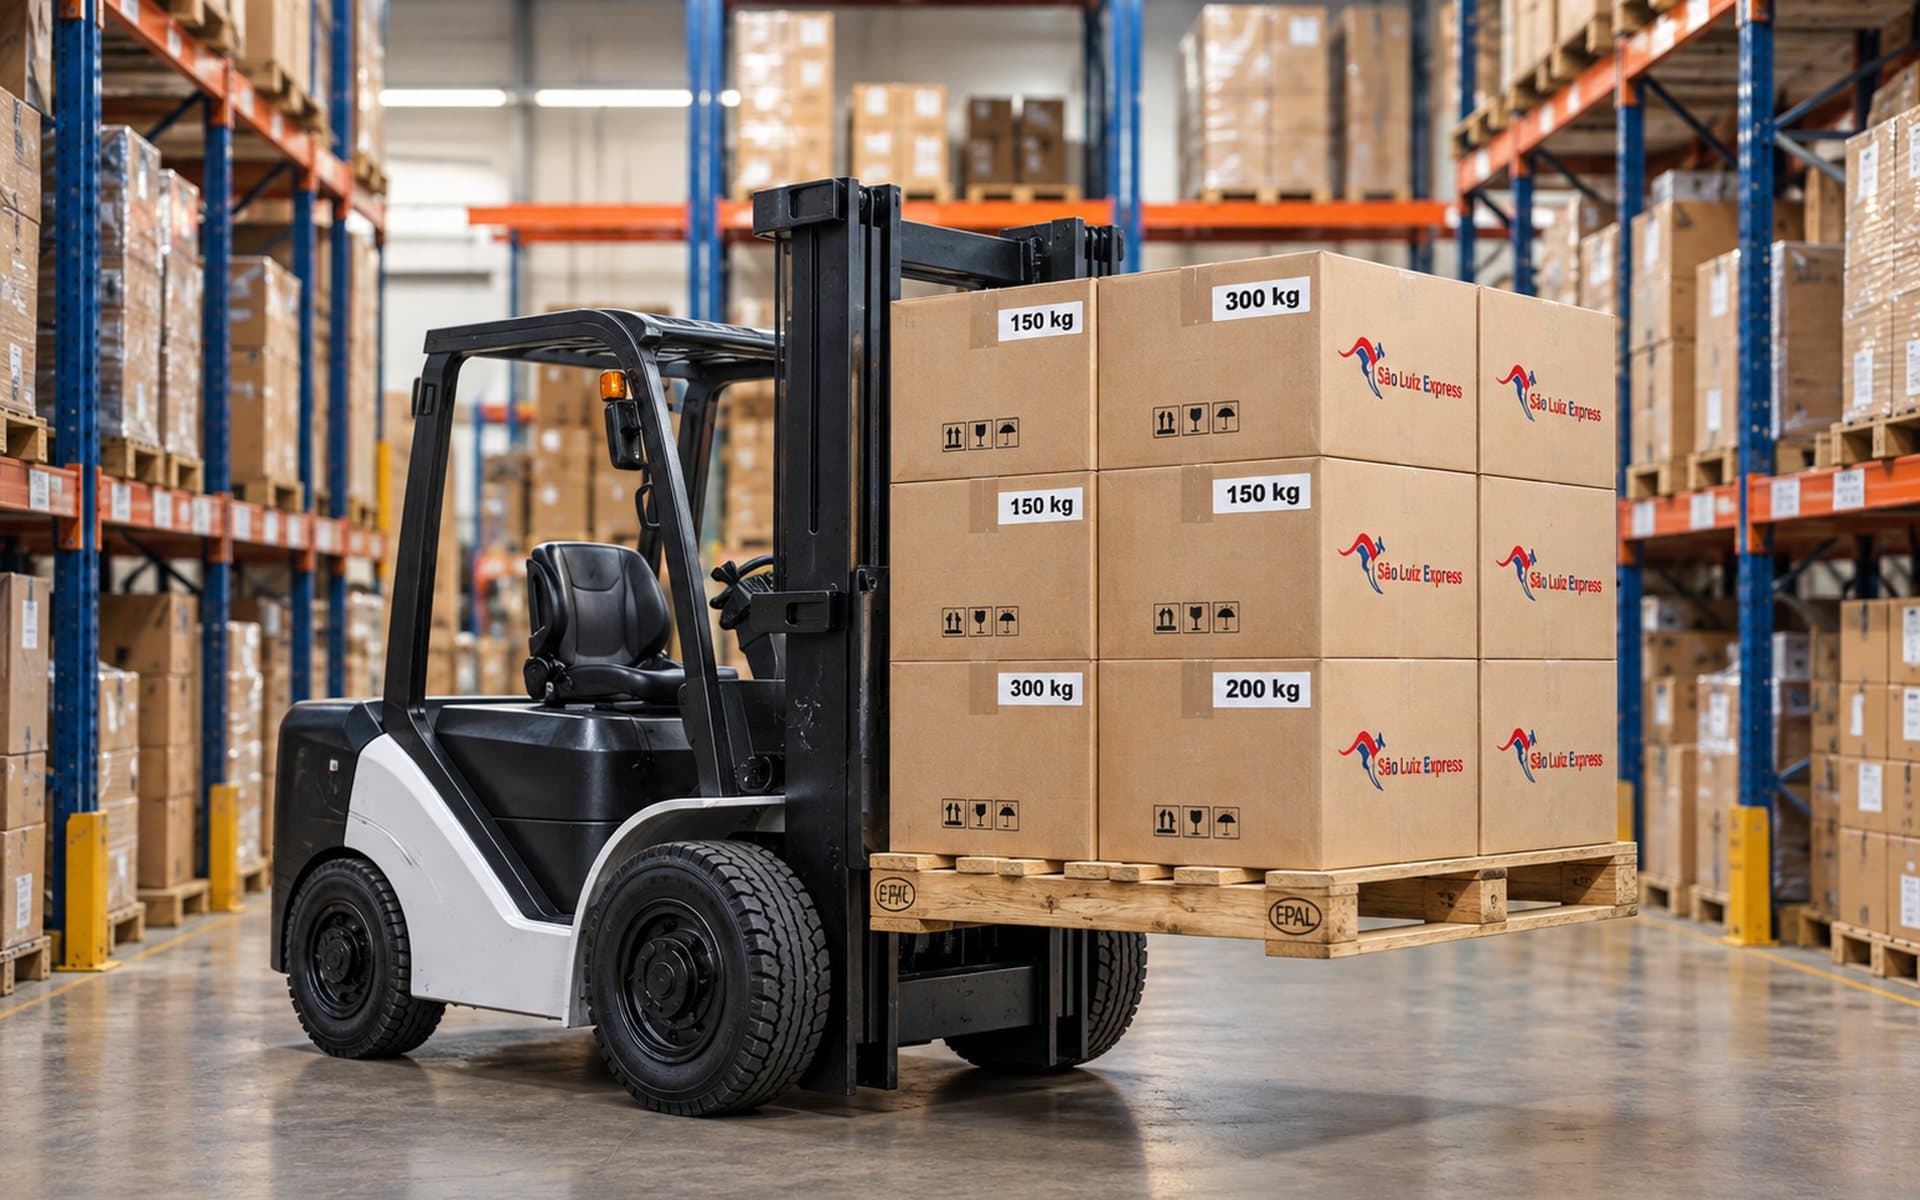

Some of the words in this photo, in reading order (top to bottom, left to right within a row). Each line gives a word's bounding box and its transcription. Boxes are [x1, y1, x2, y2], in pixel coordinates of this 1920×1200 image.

[1226, 288, 1266, 311] 300
[1272, 286, 1300, 309] kg
[1010, 312, 1044, 332] 150
[1050, 310, 1074, 331] kg
[1378, 367, 1397, 386] São
[1400, 371, 1421, 391] Luiz
[1424, 375, 1462, 399] Express
[1530, 393, 1547, 411] São
[1549, 398, 1567, 415] Luiz
[1569, 401, 1601, 422] Express
[1226, 483, 1266, 504] 150
[1272, 482, 1300, 506] kg
[1010, 496, 1044, 516] 150
[1050, 495, 1073, 517] kg
[1377, 562, 1397, 580] São
[1400, 564, 1421, 582] Luiz
[1424, 565, 1462, 588] Express
[1530, 572, 1547, 589] São
[1549, 574, 1567, 590] Luiz
[1569, 575, 1602, 595] Express
[1010, 679, 1044, 697] 300
[1050, 679, 1073, 702] kg
[1225, 679, 1266, 699] 200
[1272, 678, 1300, 703] kg
[1378, 757, 1398, 776] São
[1400, 757, 1421, 775] Luiz
[1424, 756, 1463, 778] Express
[1530, 752, 1547, 769] São
[1549, 752, 1567, 768] Luiz
[1569, 751, 1603, 771] Express
[1276, 905, 1315, 927] EPAL
